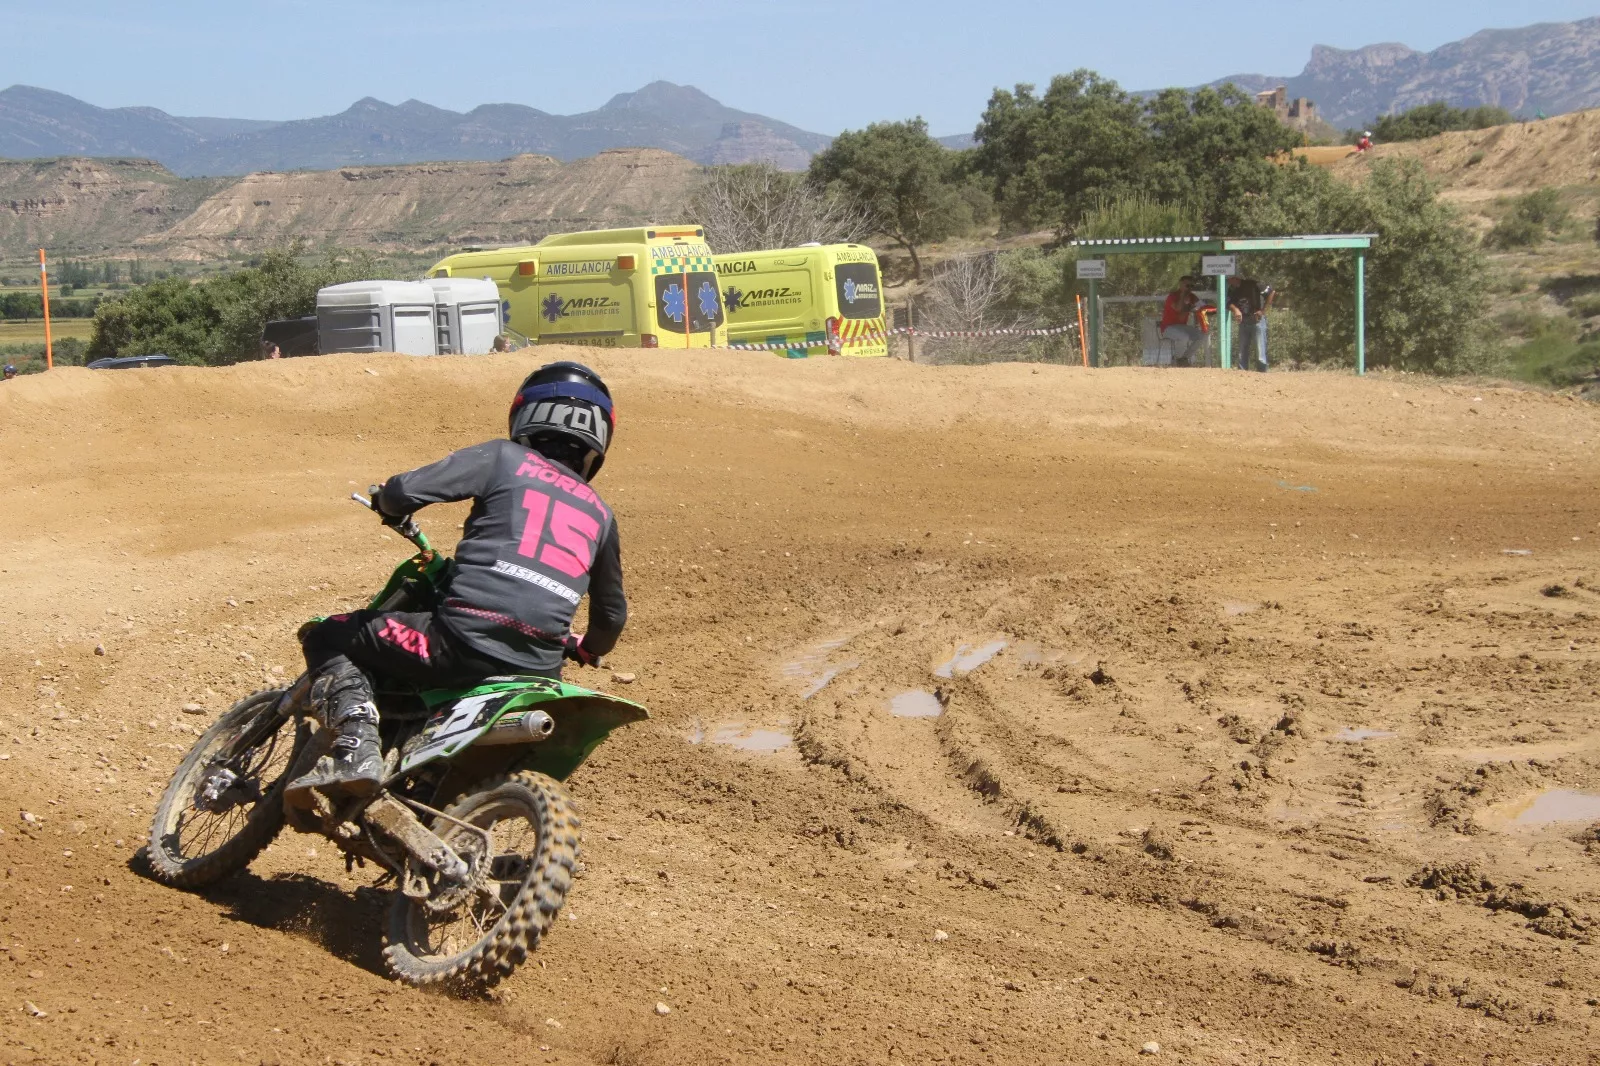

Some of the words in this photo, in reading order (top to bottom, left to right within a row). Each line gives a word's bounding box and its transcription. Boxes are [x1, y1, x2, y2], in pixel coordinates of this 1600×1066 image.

[651, 245, 711, 259] AMBULANCIA
[836, 252, 875, 261] AMBULANCIA
[546, 261, 612, 275] AMBULANCIA
[751, 297, 802, 308] AMBULANCIAS
[570, 308, 620, 317] AMBULANCIAS
[605, 337, 616, 347] 95
[517, 488, 600, 578] 15
